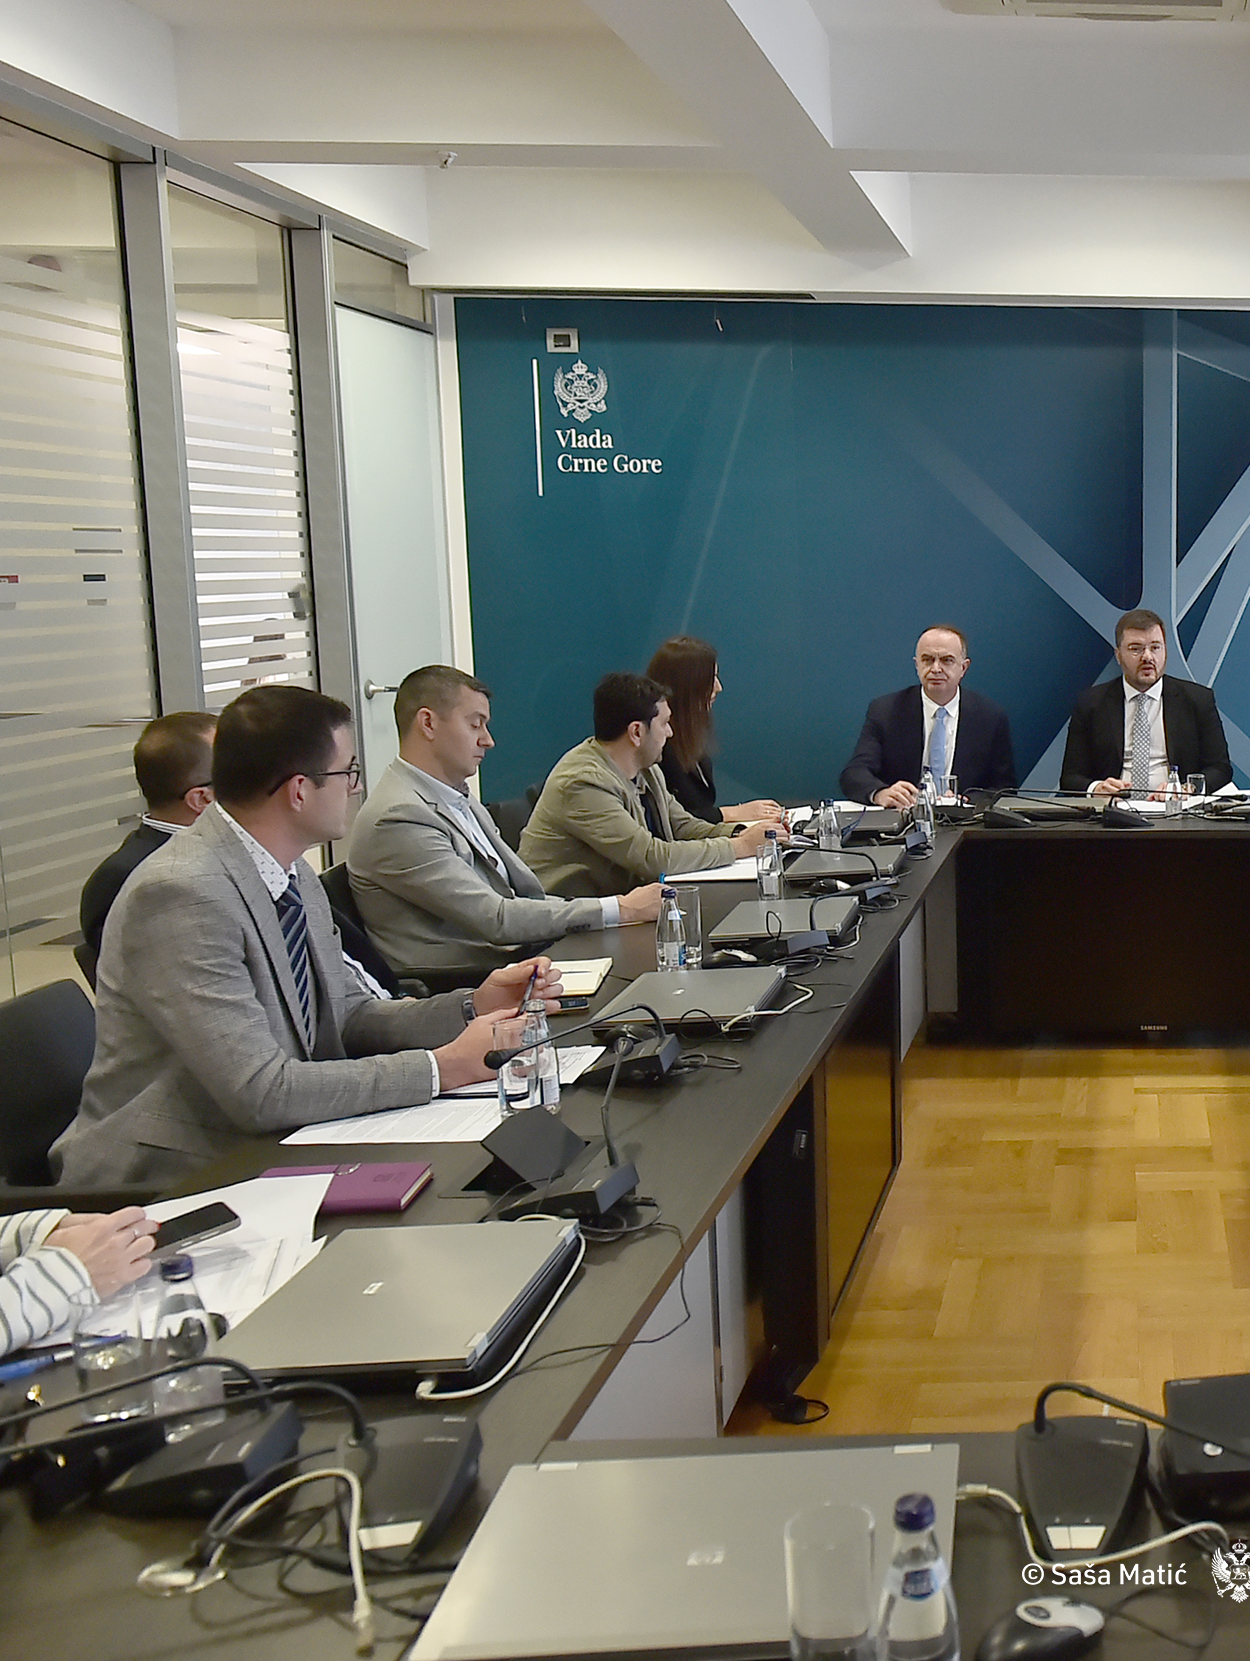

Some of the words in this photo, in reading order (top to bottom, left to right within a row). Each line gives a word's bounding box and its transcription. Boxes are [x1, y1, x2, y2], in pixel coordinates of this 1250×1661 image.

[555, 428, 614, 449] Vlada
[557, 453, 608, 473] Crne
[613, 454, 663, 474] Gore
